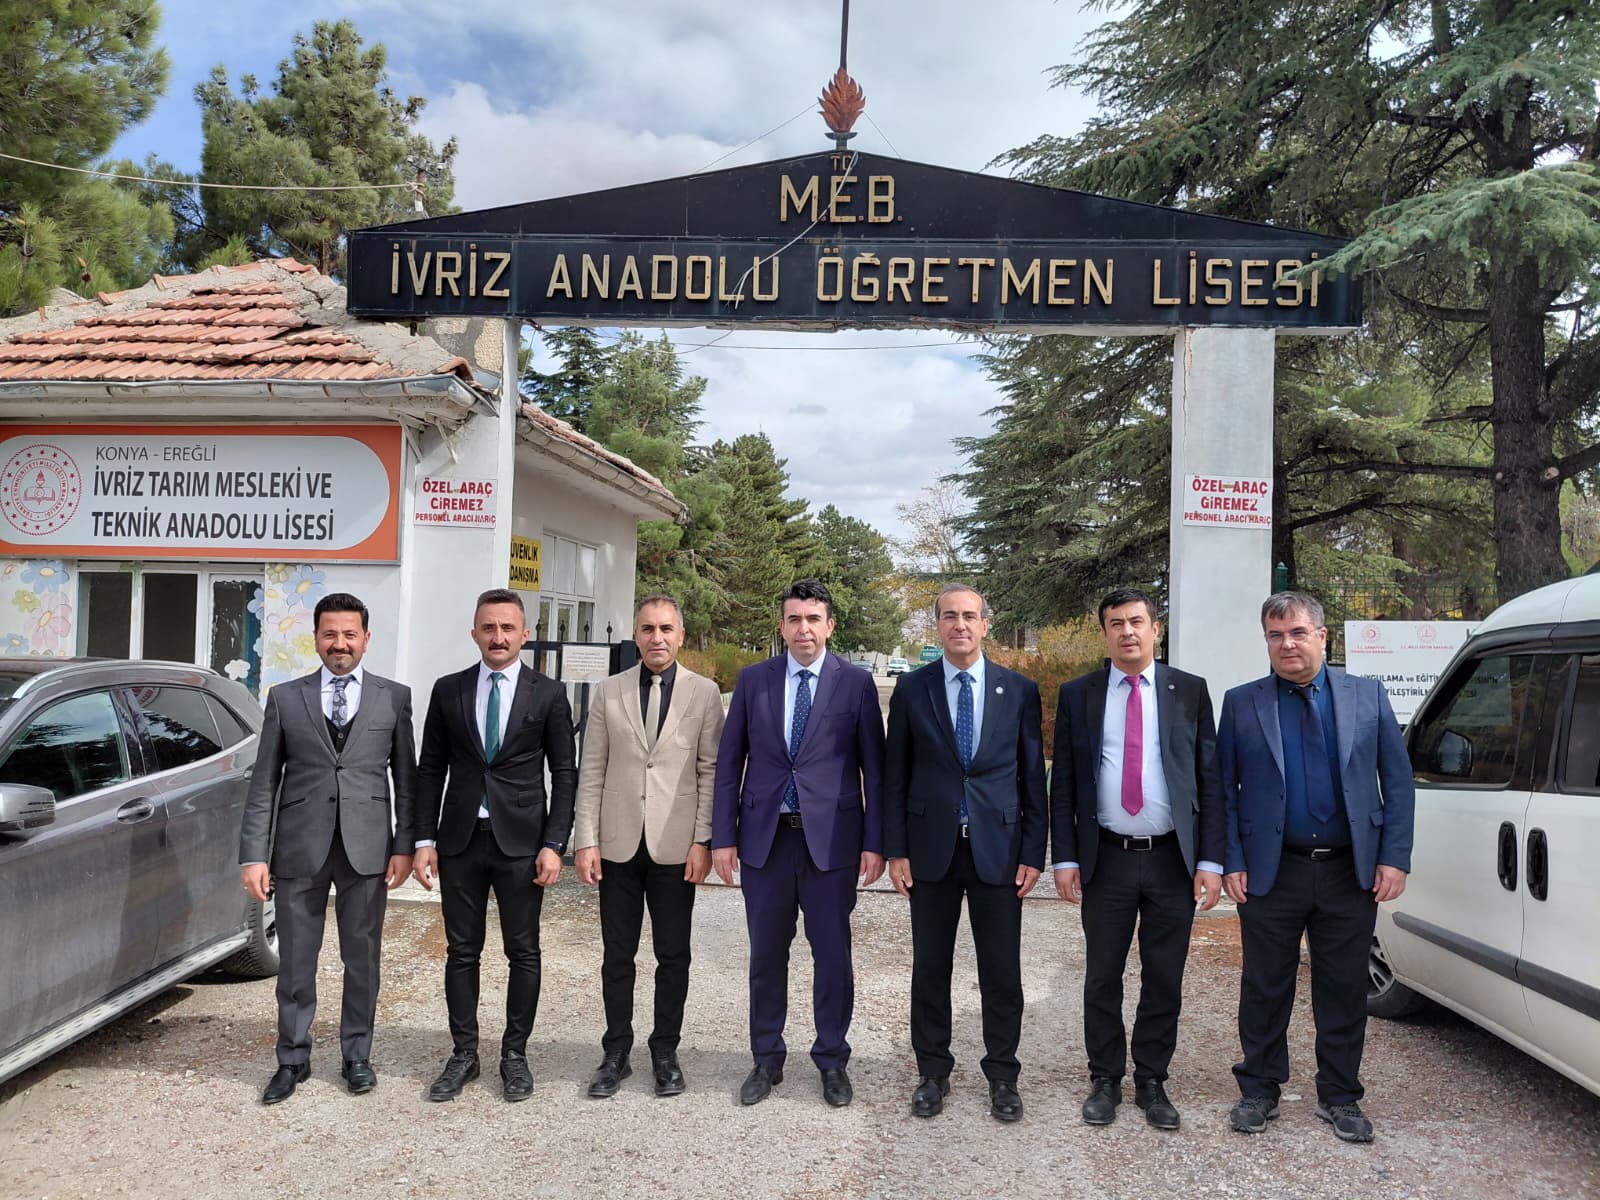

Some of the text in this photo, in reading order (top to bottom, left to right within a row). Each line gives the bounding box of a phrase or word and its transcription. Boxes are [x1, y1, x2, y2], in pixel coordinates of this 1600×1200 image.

[780, 174, 903, 223] M.E.B.
[391, 242, 1319, 308] İVRİZ ANADOLU ÖĞRETMEN LİSESİ
[96, 446, 149, 461] KONYA
[163, 444, 217, 462] EREĞLİ
[93, 465, 333, 499] İVRİZ TARIM MESLEKİ VE
[422, 477, 493, 499] ÖZEL ARAÇ
[1192, 475, 1268, 498] ÖZEL ARAÇ
[91, 506, 334, 541] TEKNİK ANADOLU LİSESİ
[415, 513, 451, 522] PERSONEL
[1184, 511, 1222, 522] PERSONEL
